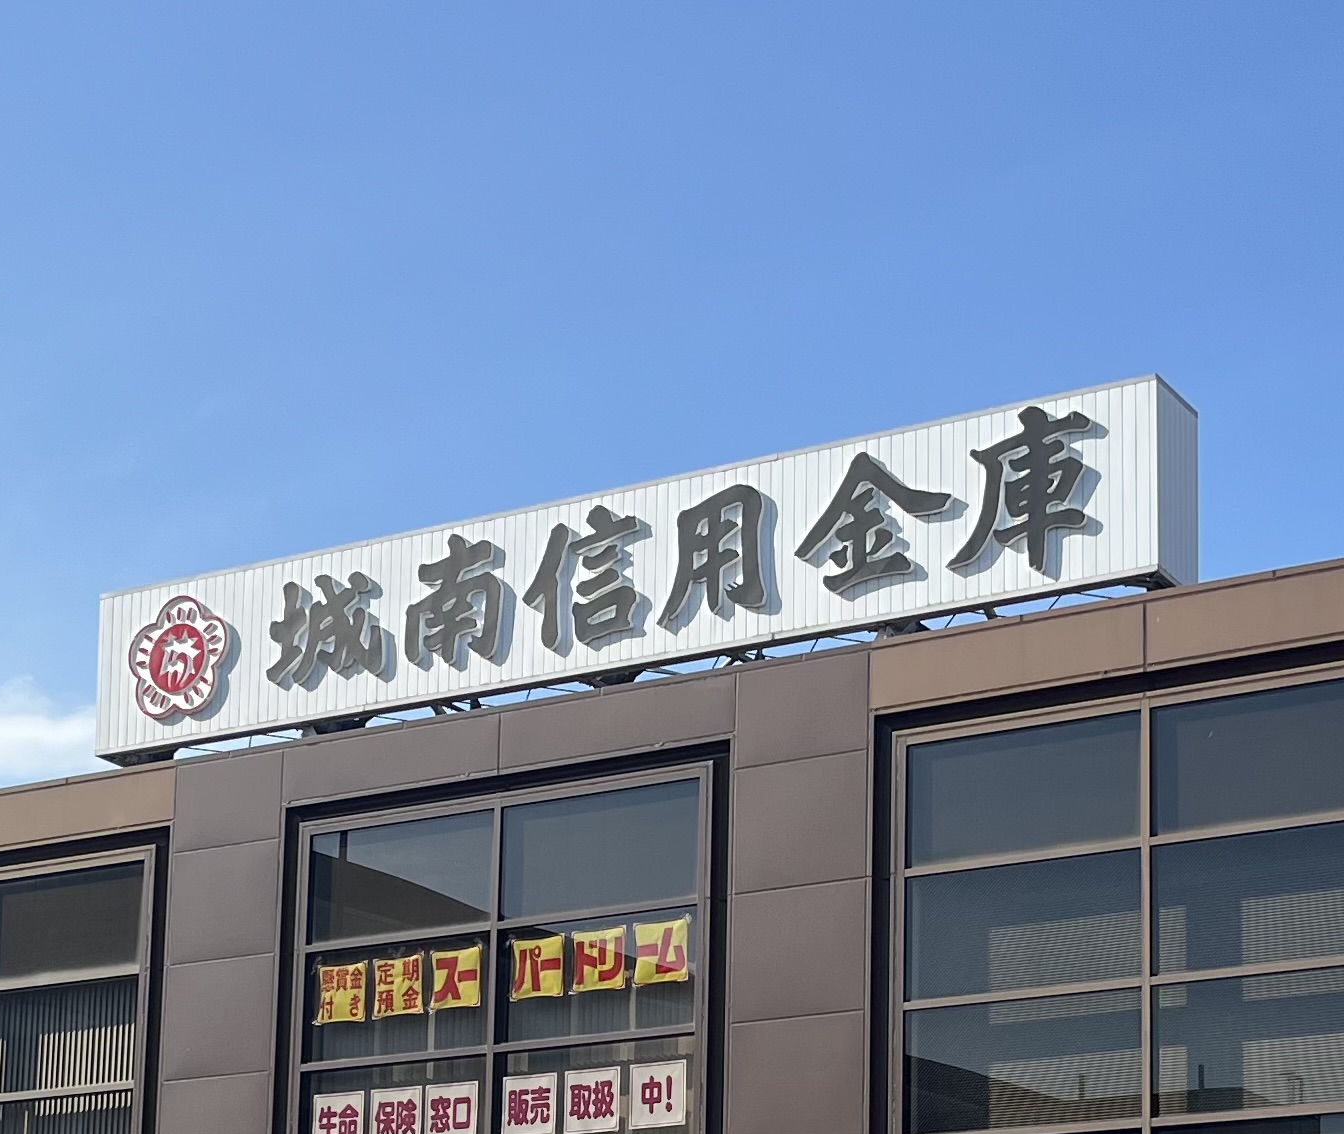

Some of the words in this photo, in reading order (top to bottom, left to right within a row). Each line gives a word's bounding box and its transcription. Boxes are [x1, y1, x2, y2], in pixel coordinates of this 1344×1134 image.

[267, 405, 1094, 686] 城南信用金庫
[321, 967, 363, 992] 懸賞金
[377, 958, 420, 987] 定期
[320, 993, 361, 1020] 付き
[377, 986, 420, 1014] 預金
